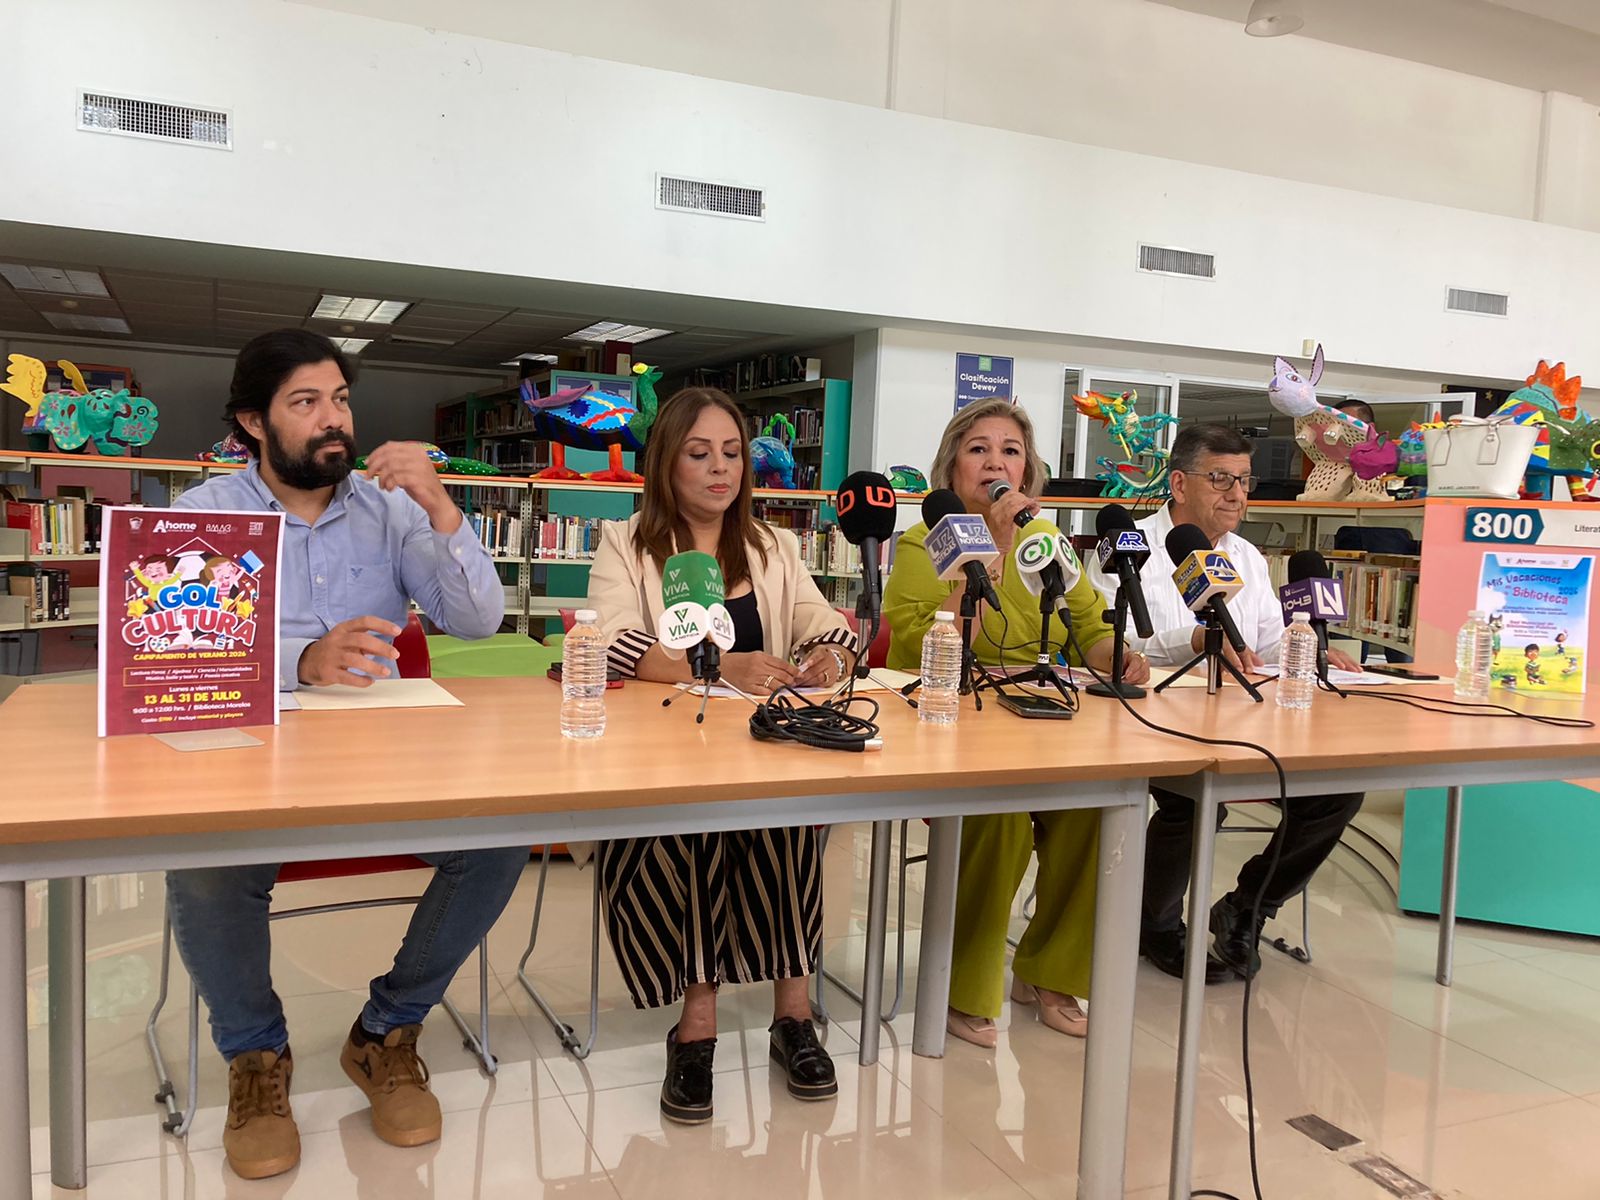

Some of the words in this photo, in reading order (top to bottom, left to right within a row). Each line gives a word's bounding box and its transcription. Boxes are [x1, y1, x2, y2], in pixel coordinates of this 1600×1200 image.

[960, 373, 1009, 384] Clasificación
[972, 382, 997, 392] Dewey
[152, 519, 197, 533] Ahome
[1472, 512, 1533, 540] 800
[959, 536, 992, 545] NOTICIAS
[663, 581, 690, 597] VIVA
[1487, 577, 1504, 589] Mis
[1506, 574, 1562, 585] Vacaciones
[159, 584, 221, 609] GOL
[1512, 586, 1569, 605] Biblioteca
[122, 608, 257, 648] CULTURA
[668, 621, 699, 637] VIVA
[133, 652, 186, 660] CAMPAMENTO
[187, 651, 197, 659] DE
[199, 651, 228, 659] VERANO
[195, 684, 218, 692] viernes
[144, 694, 157, 705] 13
[160, 693, 176, 704] AL
[178, 692, 191, 703] 31
[194, 692, 209, 702] DE
[211, 690, 242, 702] JULIO
[193, 702, 225, 710] Biblioteca
[226, 701, 251, 709] Morelos
